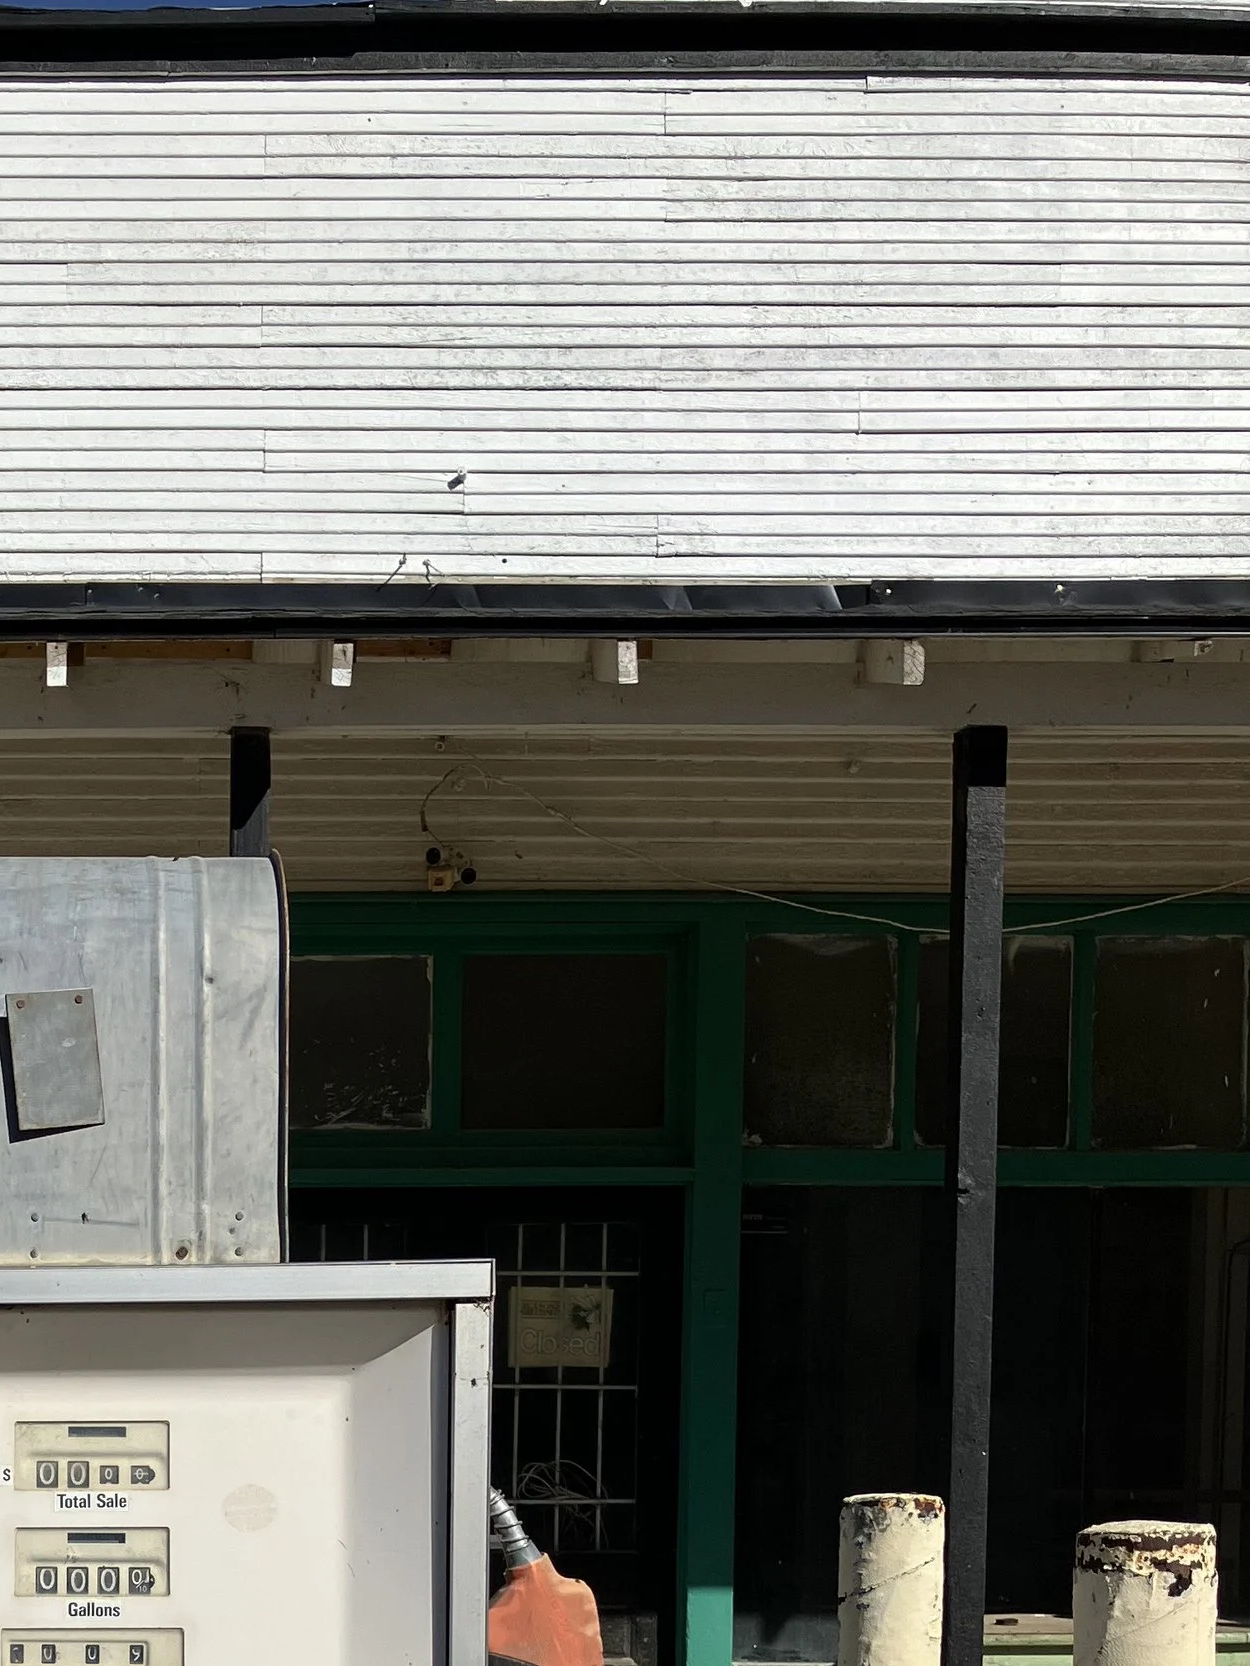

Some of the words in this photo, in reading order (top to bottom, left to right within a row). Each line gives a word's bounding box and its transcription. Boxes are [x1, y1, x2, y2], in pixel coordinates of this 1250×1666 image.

[520, 1328, 601, 1357] Closed
[56, 1494, 91, 1509] Total
[96, 1494, 127, 1508] Sale
[68, 1602, 120, 1617] Gallons
